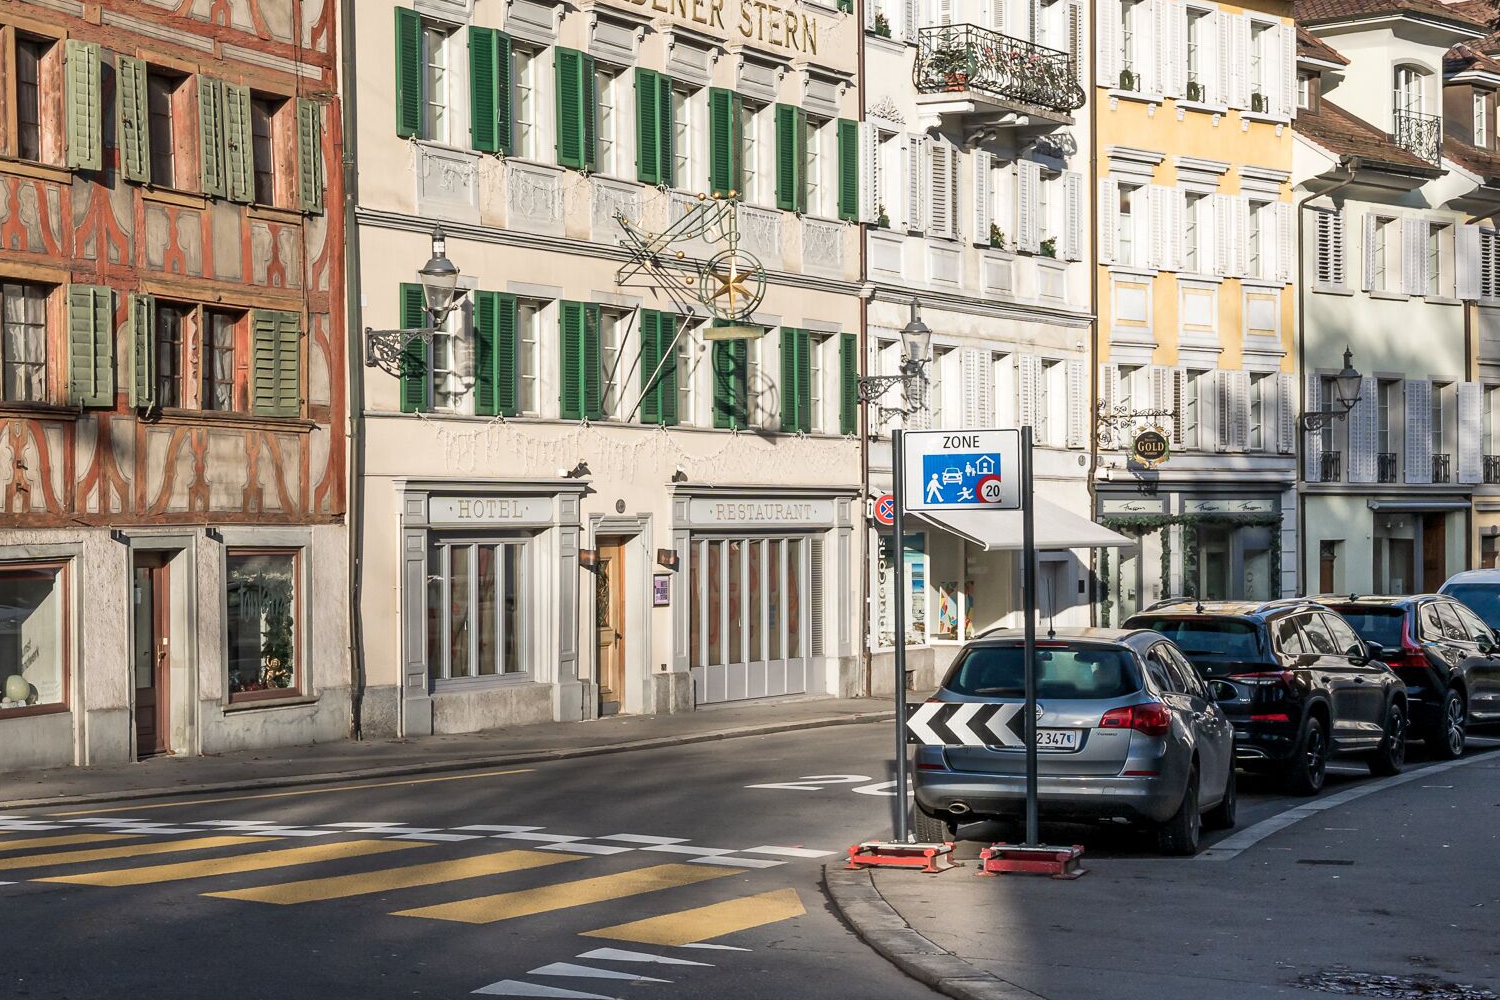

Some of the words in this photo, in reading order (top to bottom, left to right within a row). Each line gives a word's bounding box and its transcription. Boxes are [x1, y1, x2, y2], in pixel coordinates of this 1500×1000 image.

[943, 435, 980, 448] ZONE
[1137, 440, 1165, 452] GOLD
[986, 485, 1000, 497] 20
[458, 500, 523, 518] HOTEL
[715, 503, 812, 520] RESTAURANT
